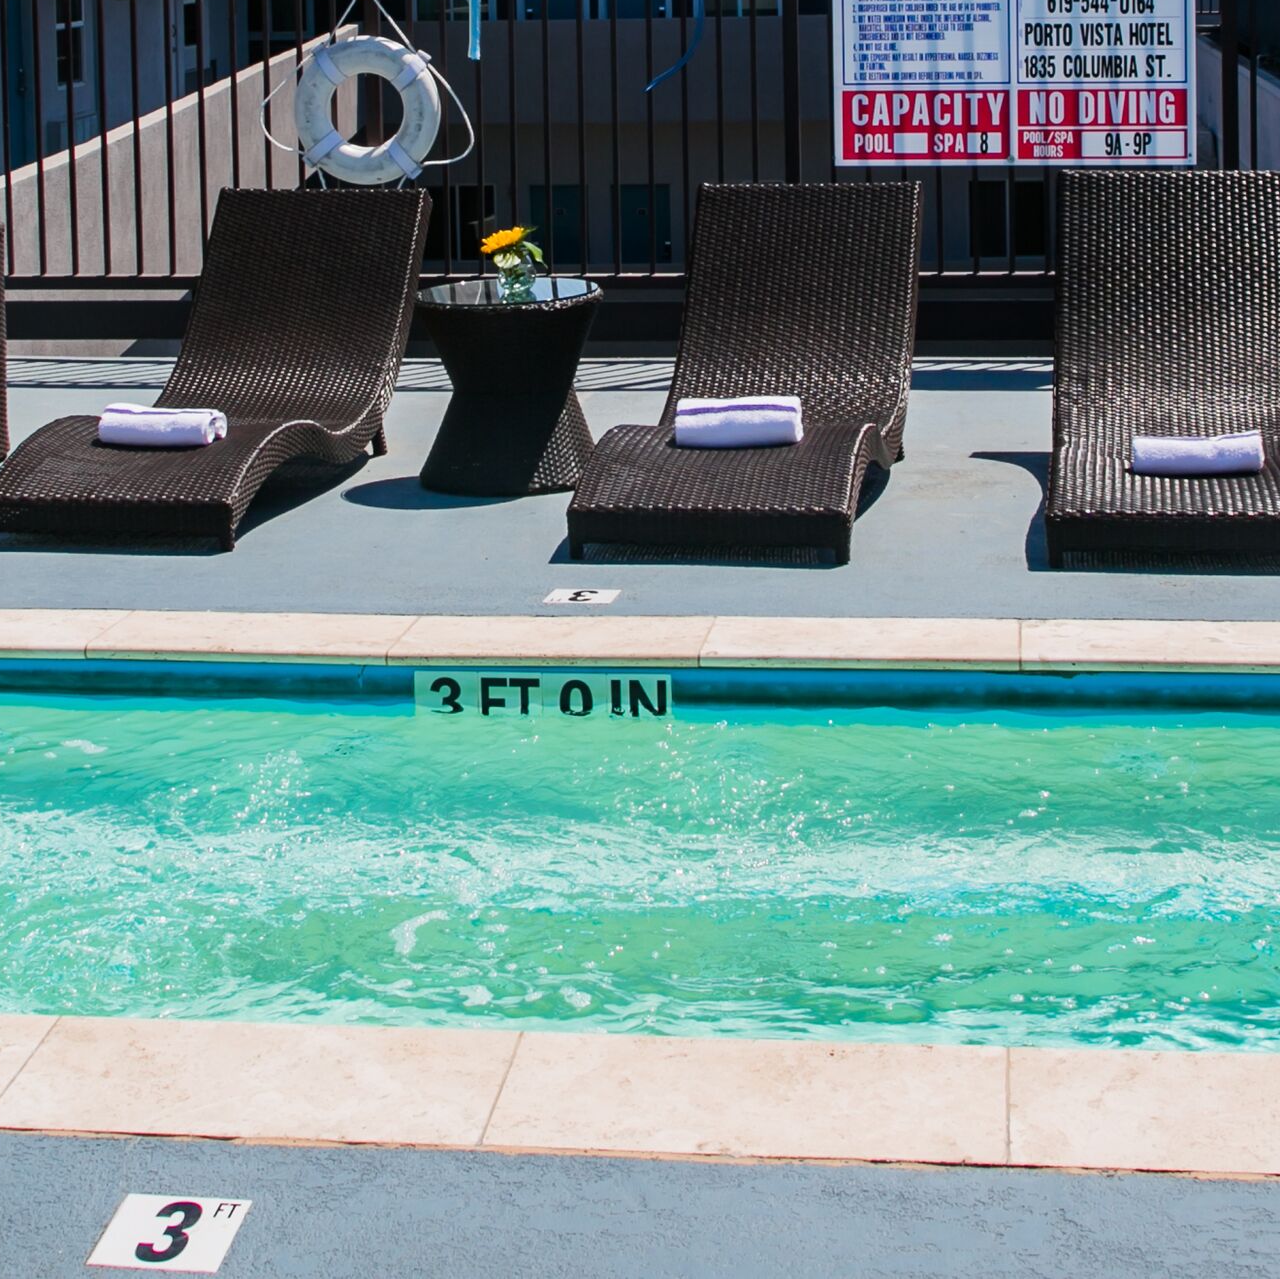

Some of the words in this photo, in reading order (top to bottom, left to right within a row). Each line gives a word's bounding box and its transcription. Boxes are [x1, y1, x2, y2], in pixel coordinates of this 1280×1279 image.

[1024, 23, 1073, 46] PORTO
[1080, 23, 1123, 46] VISTA
[1129, 22, 1173, 46] HOTEL
[1024, 55, 1056, 78] 1835
[1063, 55, 1138, 78] COLUMBIA
[1145, 54, 1171, 78] ST.
[851, 93, 1004, 126] CAPACITY
[1029, 91, 1065, 124] NO
[1079, 91, 1176, 124] DIVING
[854, 133, 892, 153] POOL
[933, 132, 964, 153] SPA
[980, 132, 988, 153] 8
[1023, 131, 1074, 144] POOL/SPA
[1033, 145, 1064, 157] HOURS
[429, 676, 464, 714] 3
[480, 677, 540, 716] FT
[610, 679, 667, 717] IN
[134, 1200, 203, 1263] 3
[213, 1203, 242, 1219] FT
